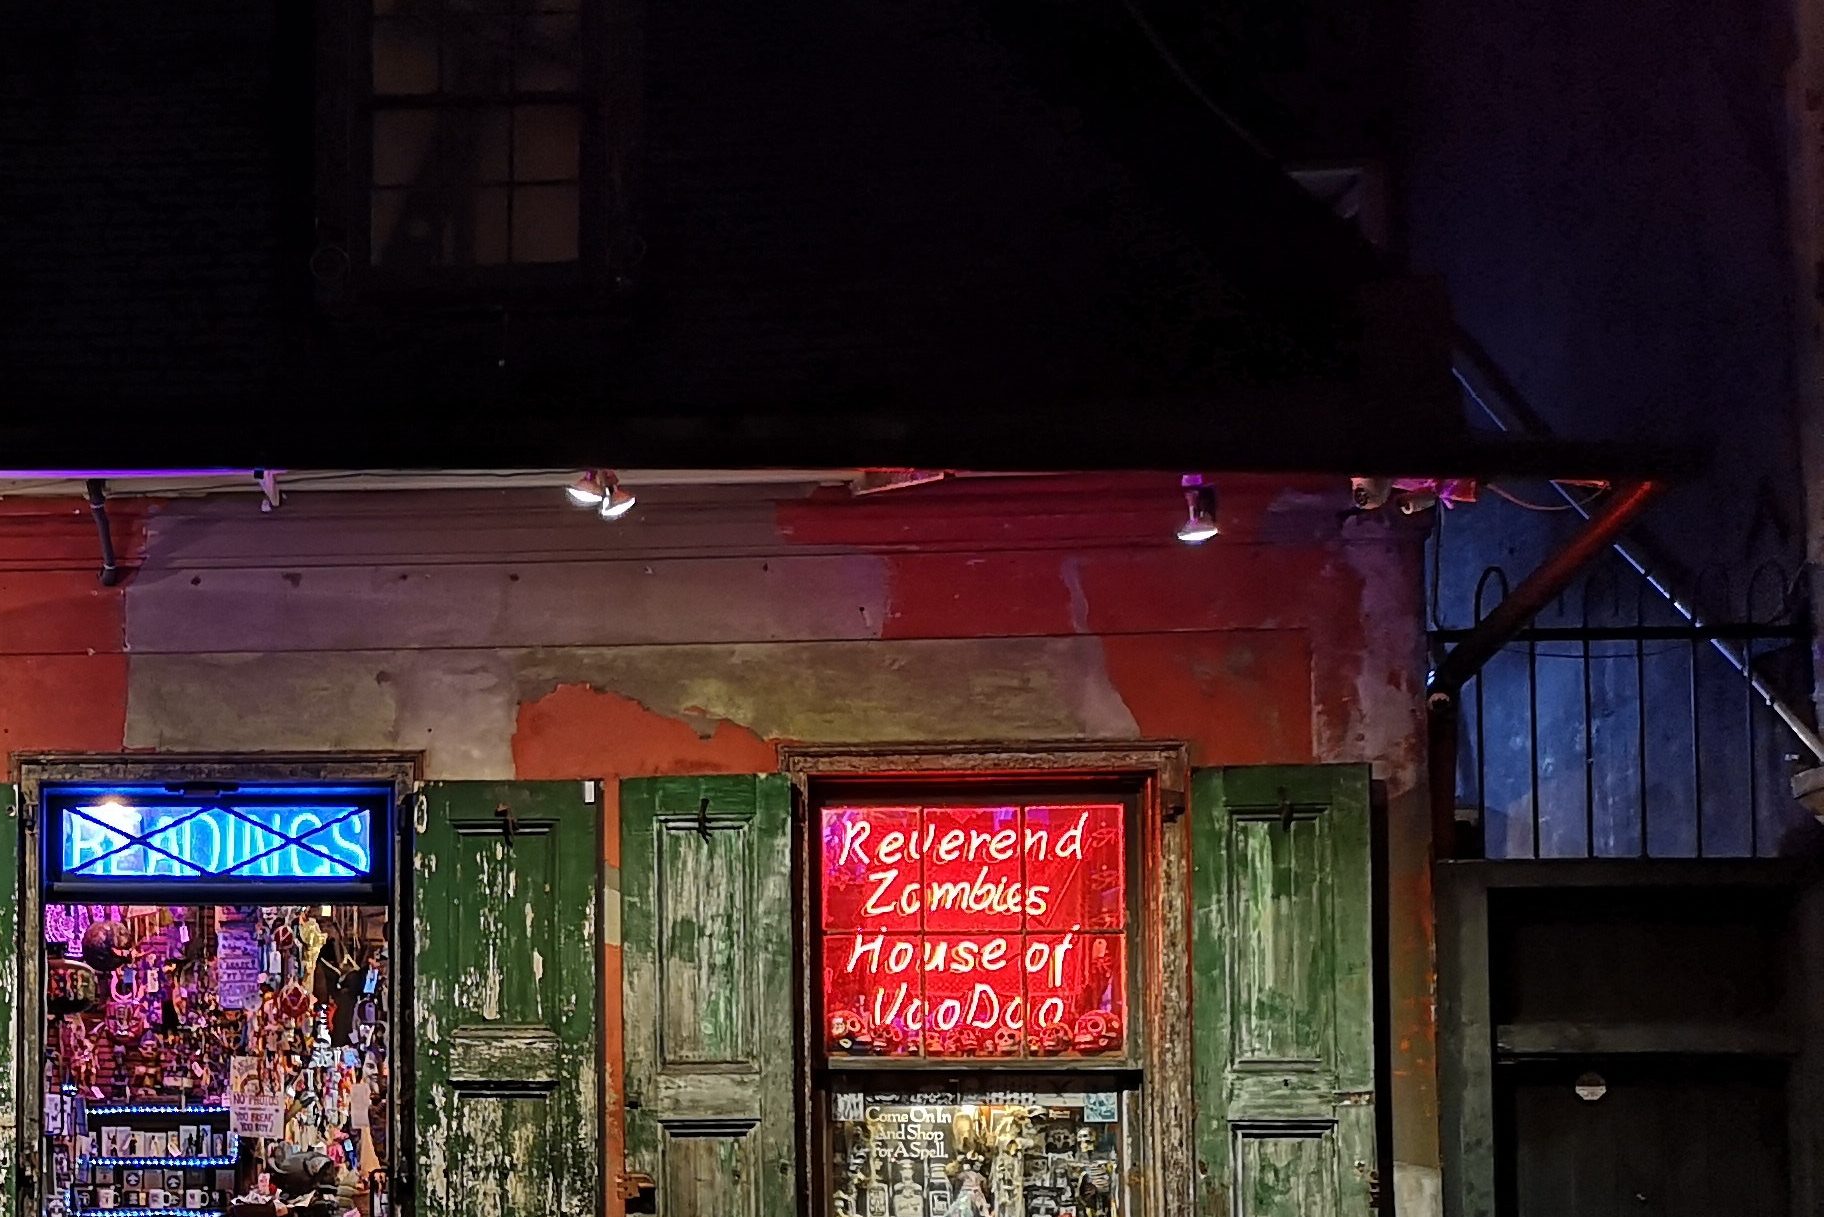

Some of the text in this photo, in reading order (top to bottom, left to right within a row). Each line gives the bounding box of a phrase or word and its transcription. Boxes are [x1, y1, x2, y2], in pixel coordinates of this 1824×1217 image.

[71, 810, 368, 876] READINGS
[839, 811, 1089, 866] Reverend
[863, 866, 1050, 916] Zombies
[846, 923, 1081, 989] House of
[233, 1093, 279, 1106] NO PHOTOS
[235, 1111, 249, 1121] YOU
[865, 1106, 952, 1124] Come On In
[240, 1121, 254, 1132] YOU
[876, 1124, 944, 1144] And Shop
[870, 1141, 949, 1161] For A Spell.
